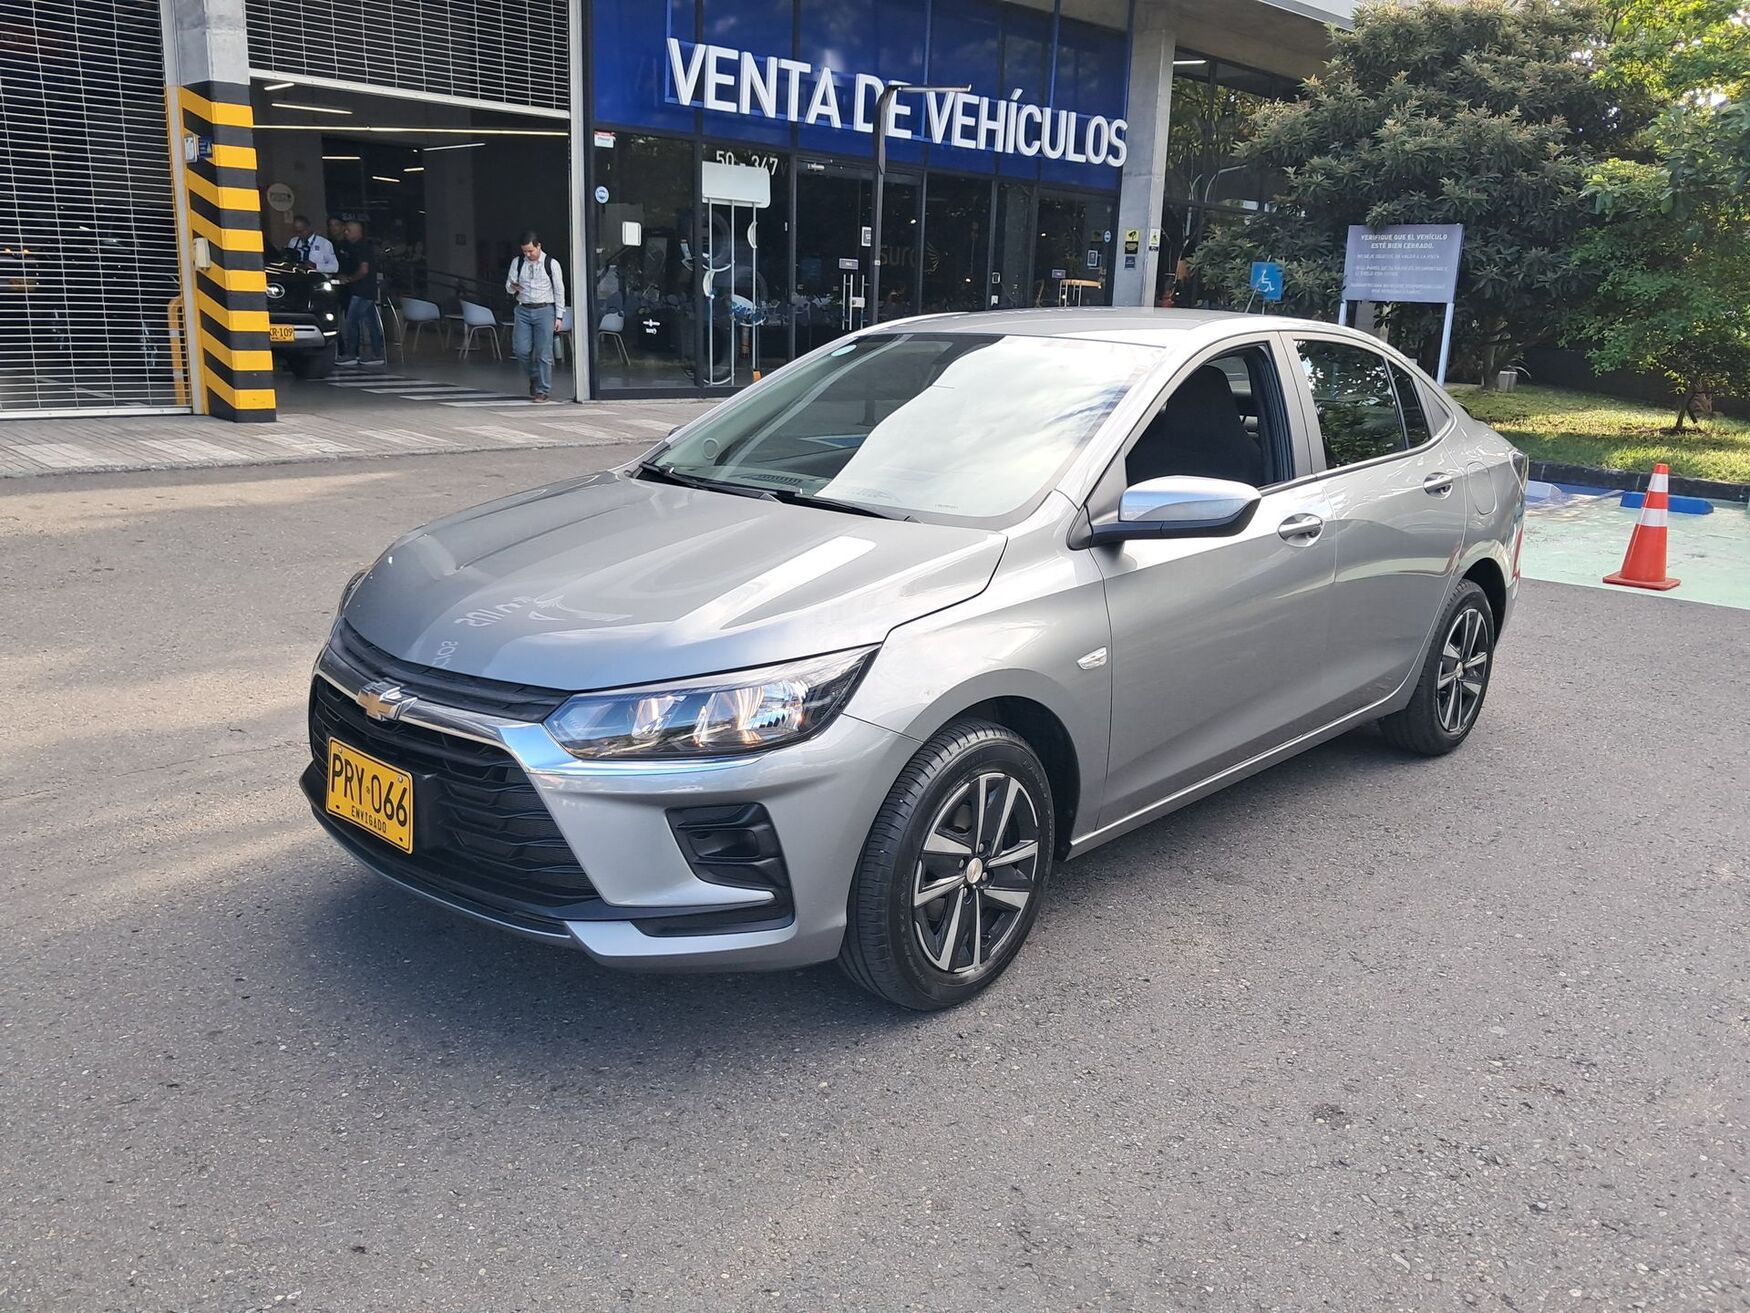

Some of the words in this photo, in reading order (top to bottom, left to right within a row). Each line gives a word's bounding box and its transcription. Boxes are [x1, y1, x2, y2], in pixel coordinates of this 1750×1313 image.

[667, 38, 842, 128] VENTA
[853, 73, 912, 140] DE
[926, 88, 1128, 167] VEHÍCULOS
[1416, 233, 1448, 241] VEHÍCULO
[351, 805, 387, 834] ENVIGADO
